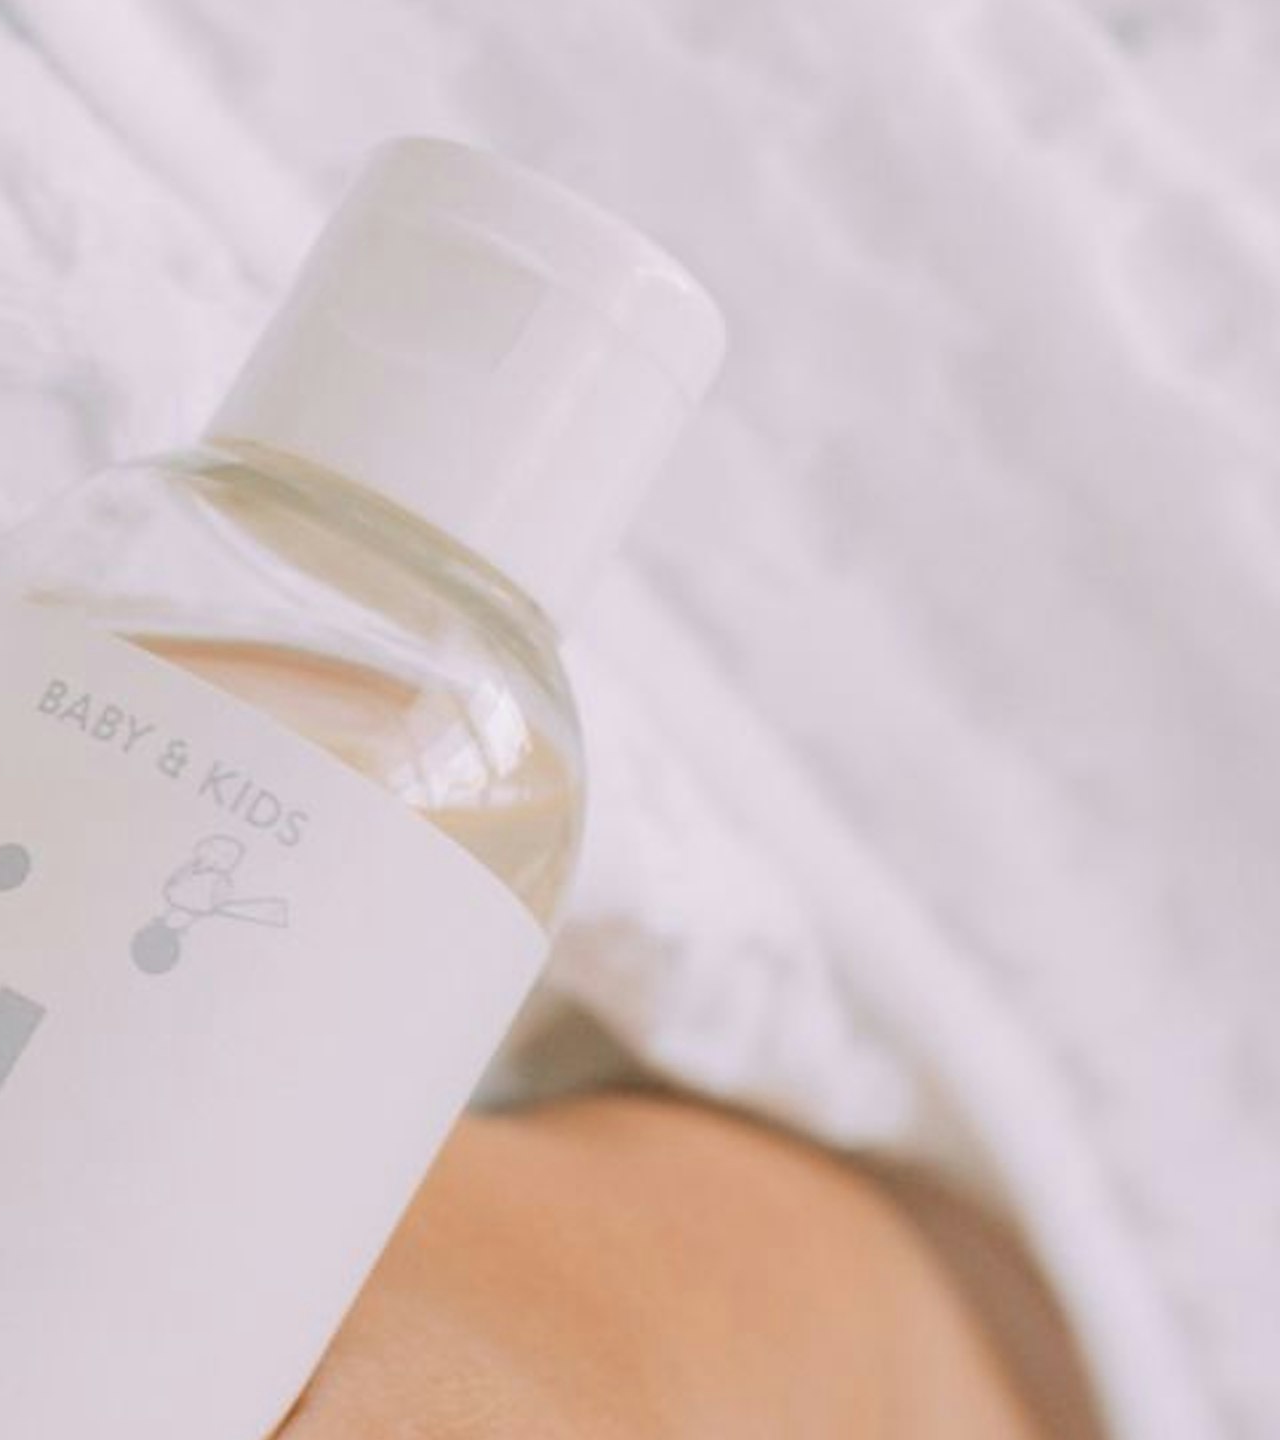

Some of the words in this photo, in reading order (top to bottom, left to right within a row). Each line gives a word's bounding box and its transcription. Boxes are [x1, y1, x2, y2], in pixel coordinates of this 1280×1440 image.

[36, 678, 156, 754] BABY
[157, 737, 189, 779] &
[196, 761, 311, 848] KIDS
